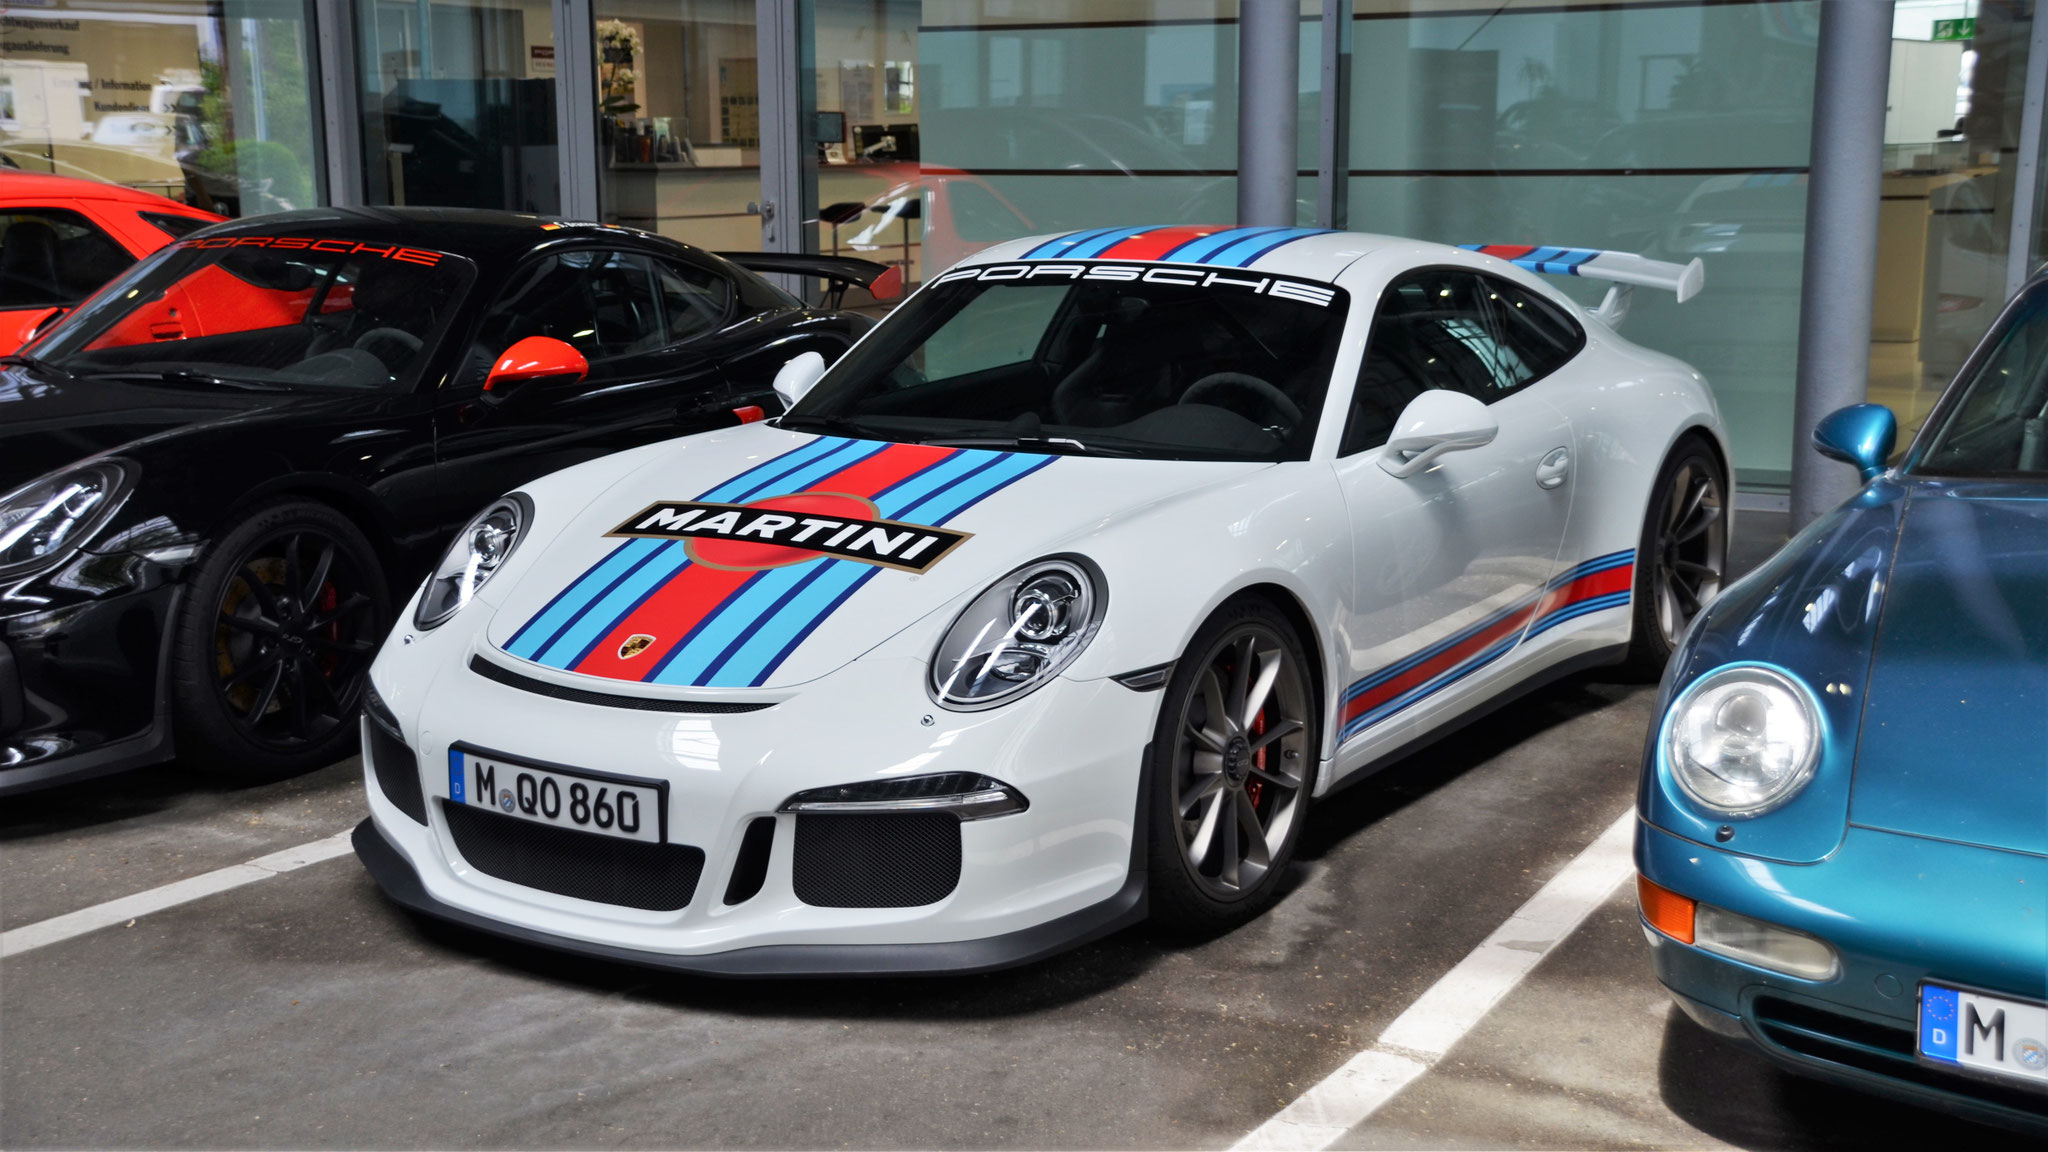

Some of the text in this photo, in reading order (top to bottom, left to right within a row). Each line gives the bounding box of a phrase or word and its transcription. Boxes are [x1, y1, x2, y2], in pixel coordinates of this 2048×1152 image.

[176, 236, 443, 267] PORSCHE
[931, 264, 1335, 307] PORSCHE
[635, 507, 939, 560] MARTINI
[475, 762, 496, 806] M
[569, 782, 640, 833] 860
[1932, 1027, 1947, 1045] D
[1965, 1001, 2005, 1062] M
